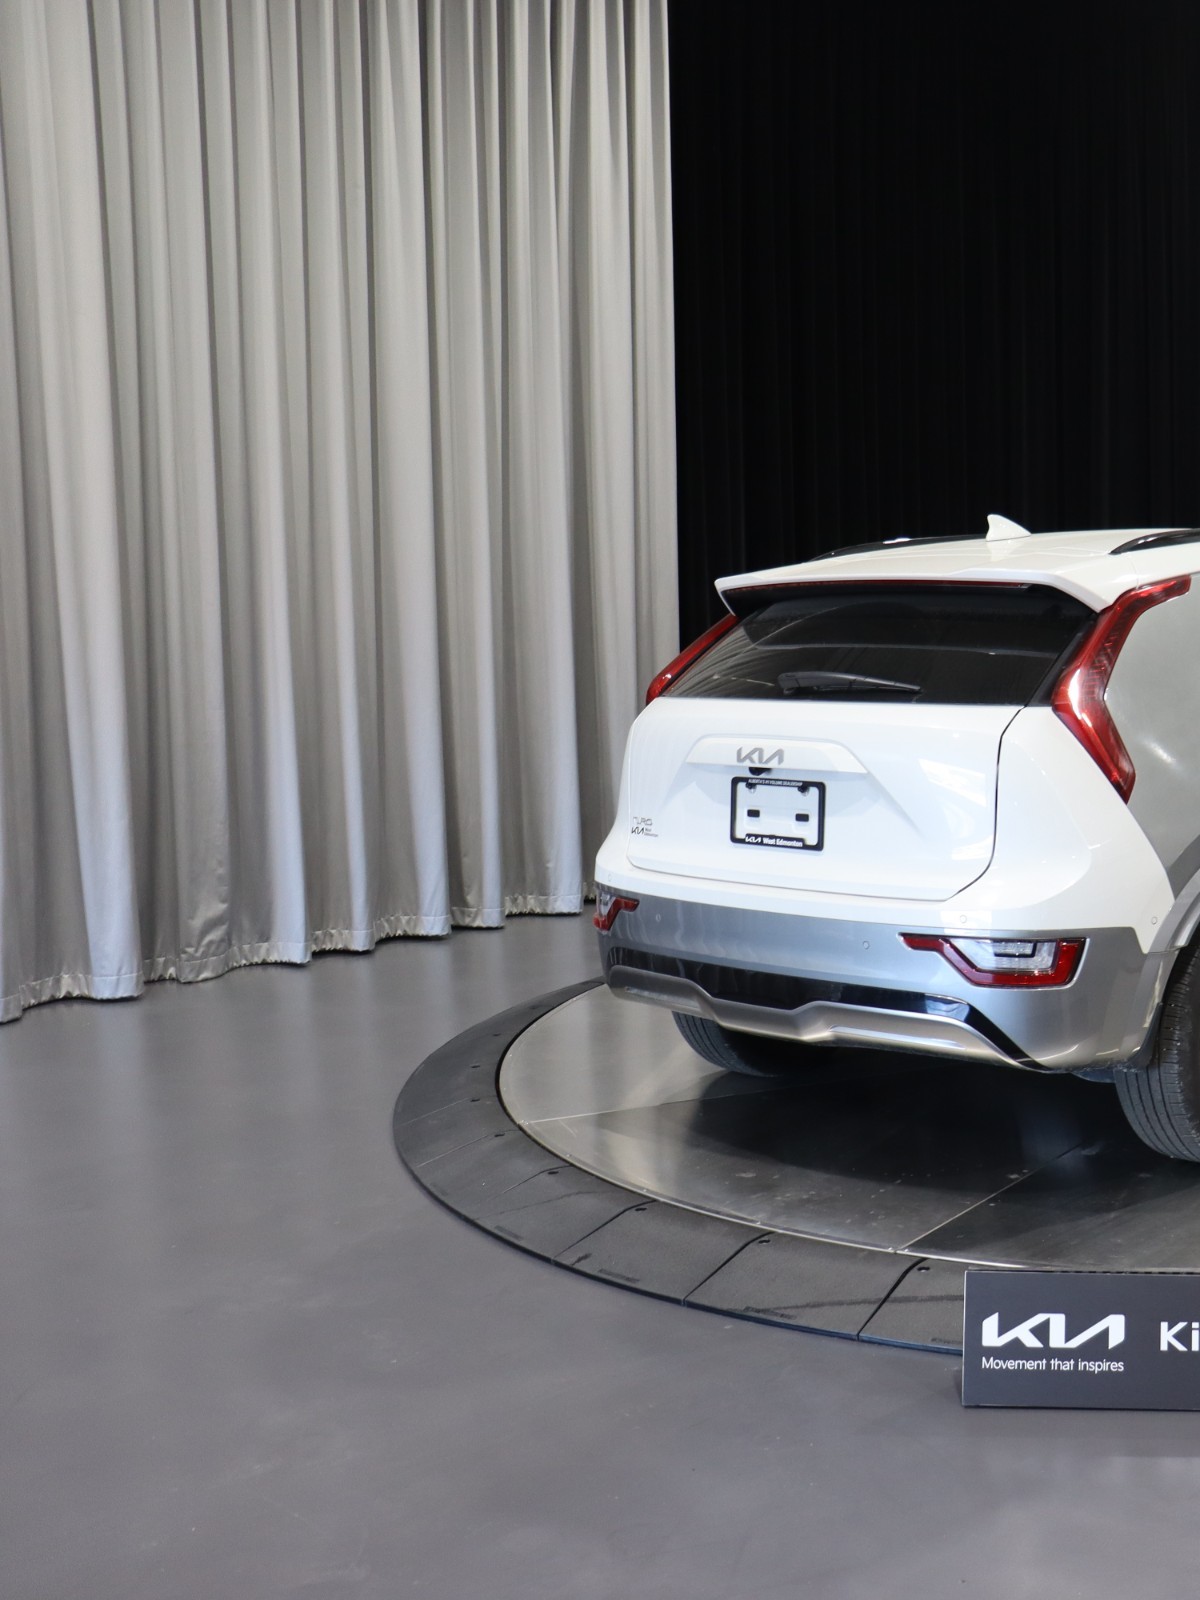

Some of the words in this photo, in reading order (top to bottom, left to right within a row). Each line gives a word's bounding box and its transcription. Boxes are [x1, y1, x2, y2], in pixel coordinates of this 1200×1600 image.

[736, 747, 784, 765] KIA
[762, 837, 776, 845] West
[776, 838, 803, 847] Edmonton
[982, 1312, 1126, 1350] KIA
[981, 1356, 1047, 1371] Movement
[1050, 1357, 1075, 1371] that
[1078, 1358, 1125, 1375] inspires
